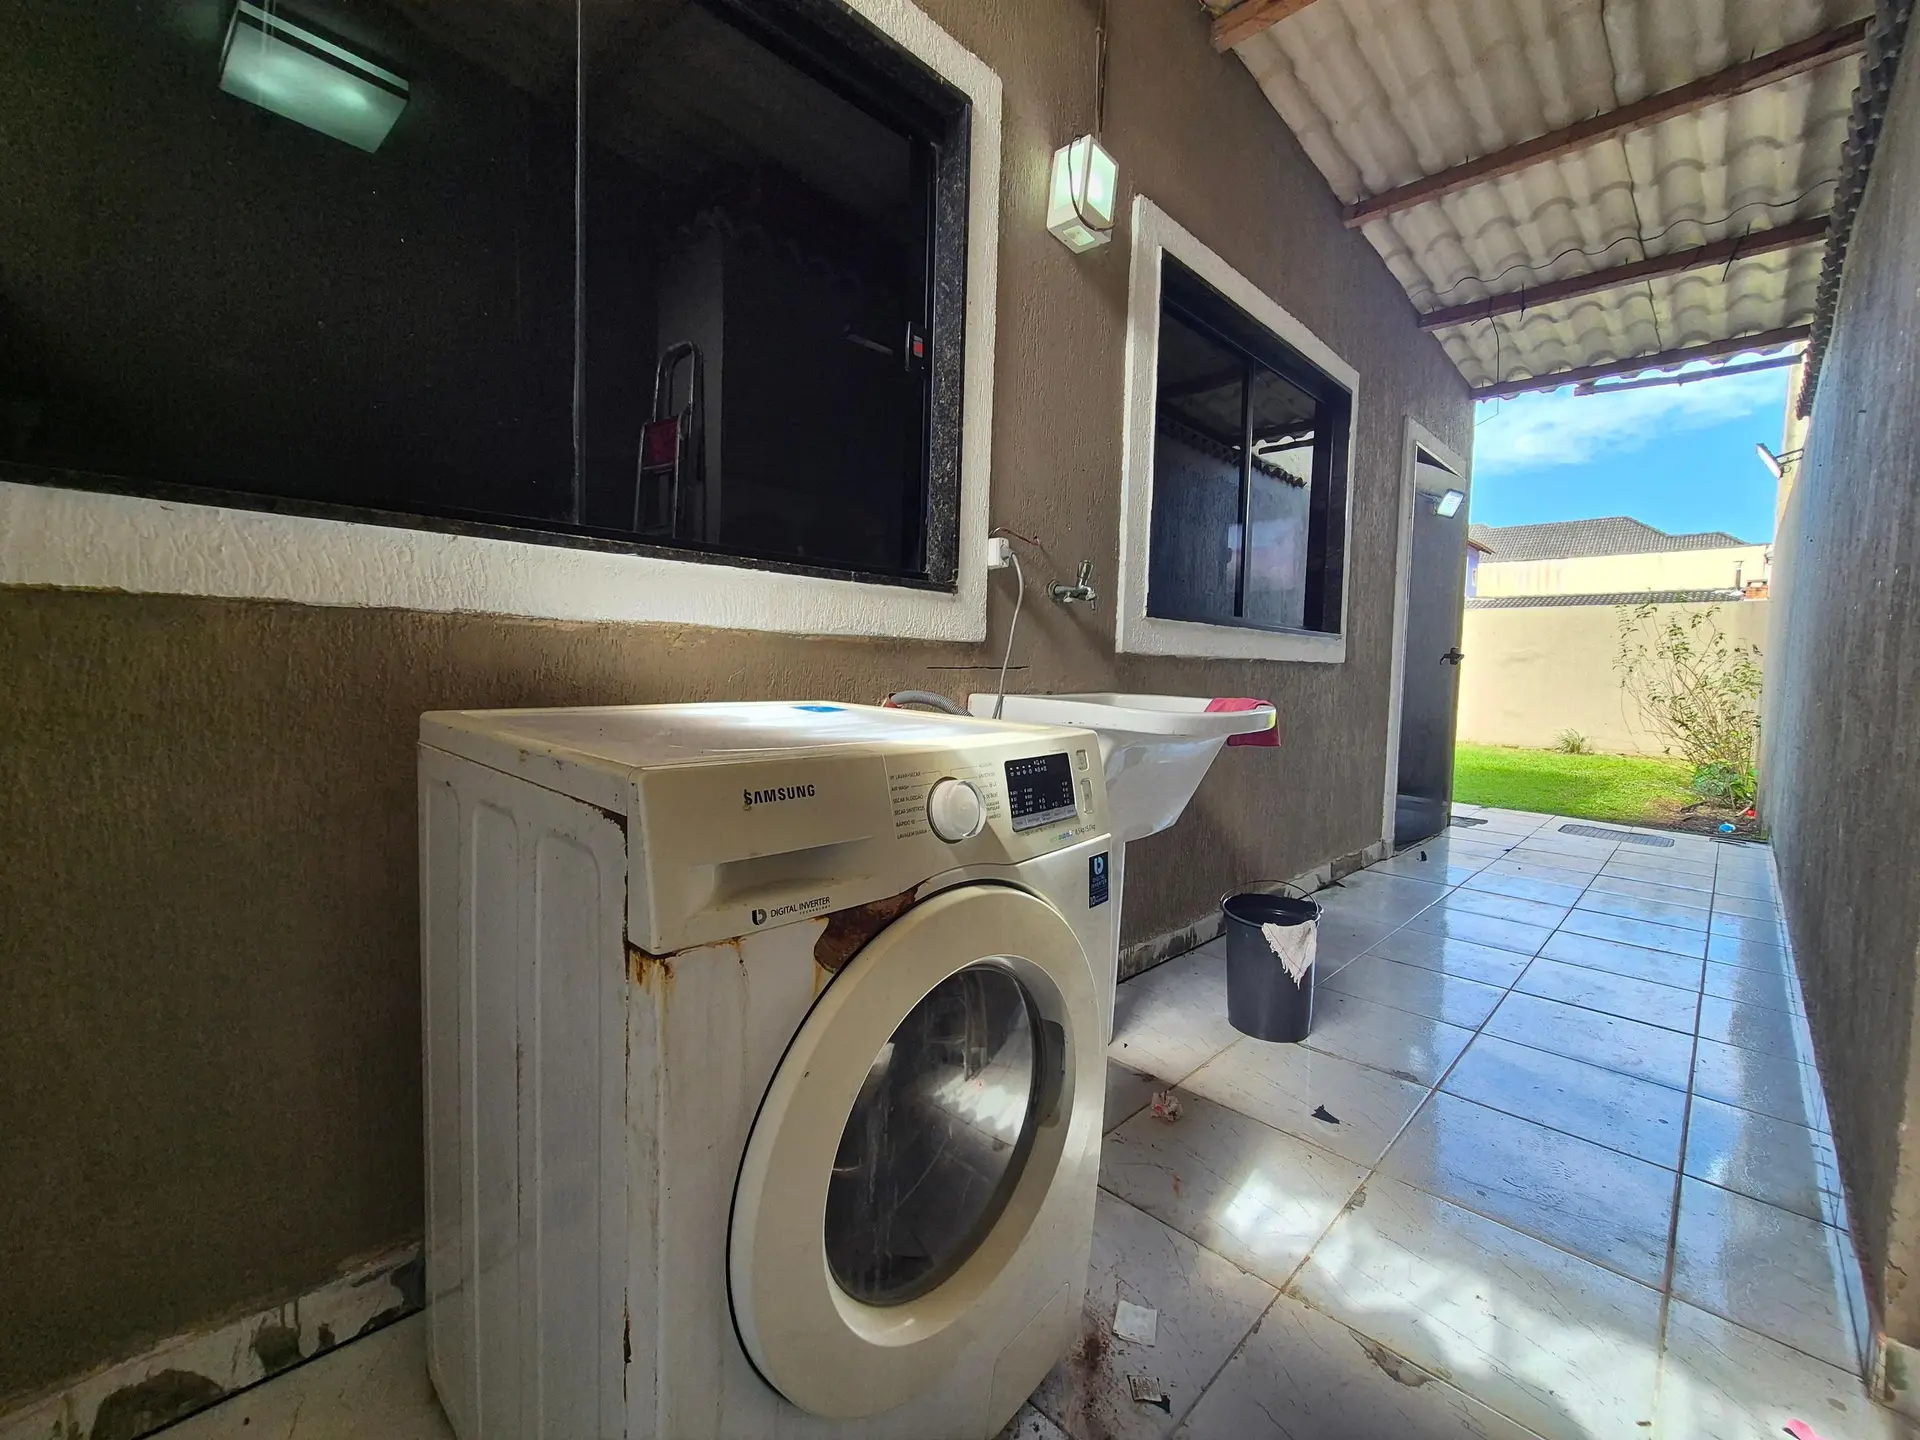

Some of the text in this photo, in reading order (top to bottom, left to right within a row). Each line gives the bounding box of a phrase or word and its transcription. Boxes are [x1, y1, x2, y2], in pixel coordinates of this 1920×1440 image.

[743, 784, 815, 806] SAMSUNG
[770, 896, 830, 918] DIGITAL INVERTER
